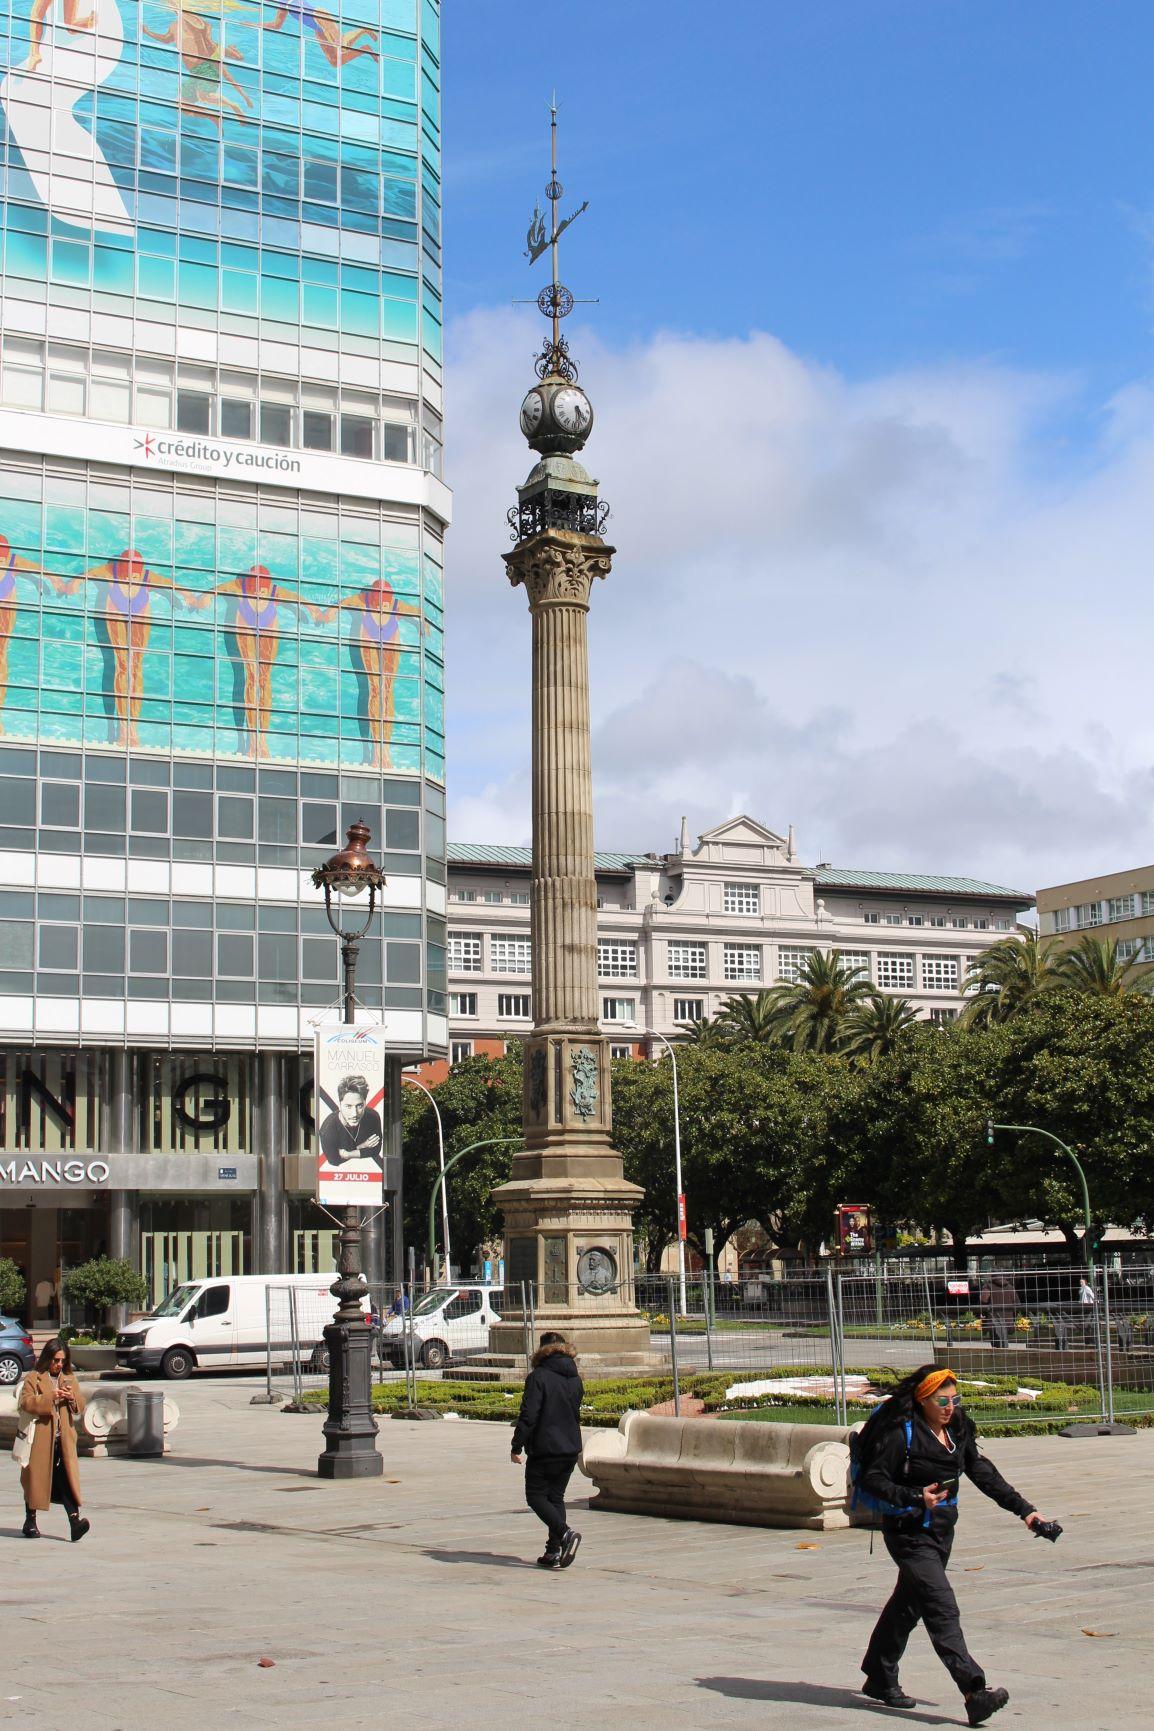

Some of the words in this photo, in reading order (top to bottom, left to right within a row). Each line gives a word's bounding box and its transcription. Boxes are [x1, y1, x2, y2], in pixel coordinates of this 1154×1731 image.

[157, 439, 220, 462] crédito
[222, 450, 234, 467] y
[236, 451, 301, 473] caución
[158, 457, 188, 469] Atradius
[190, 462, 213, 473] Group
[328, 1050, 380, 1063] MANUEL
[328, 1061, 380, 1071] CARRASCO
[0, 1160, 110, 1182] MANGO
[334, 1173, 343, 1181] 27
[345, 1173, 369, 1181] JULIO
